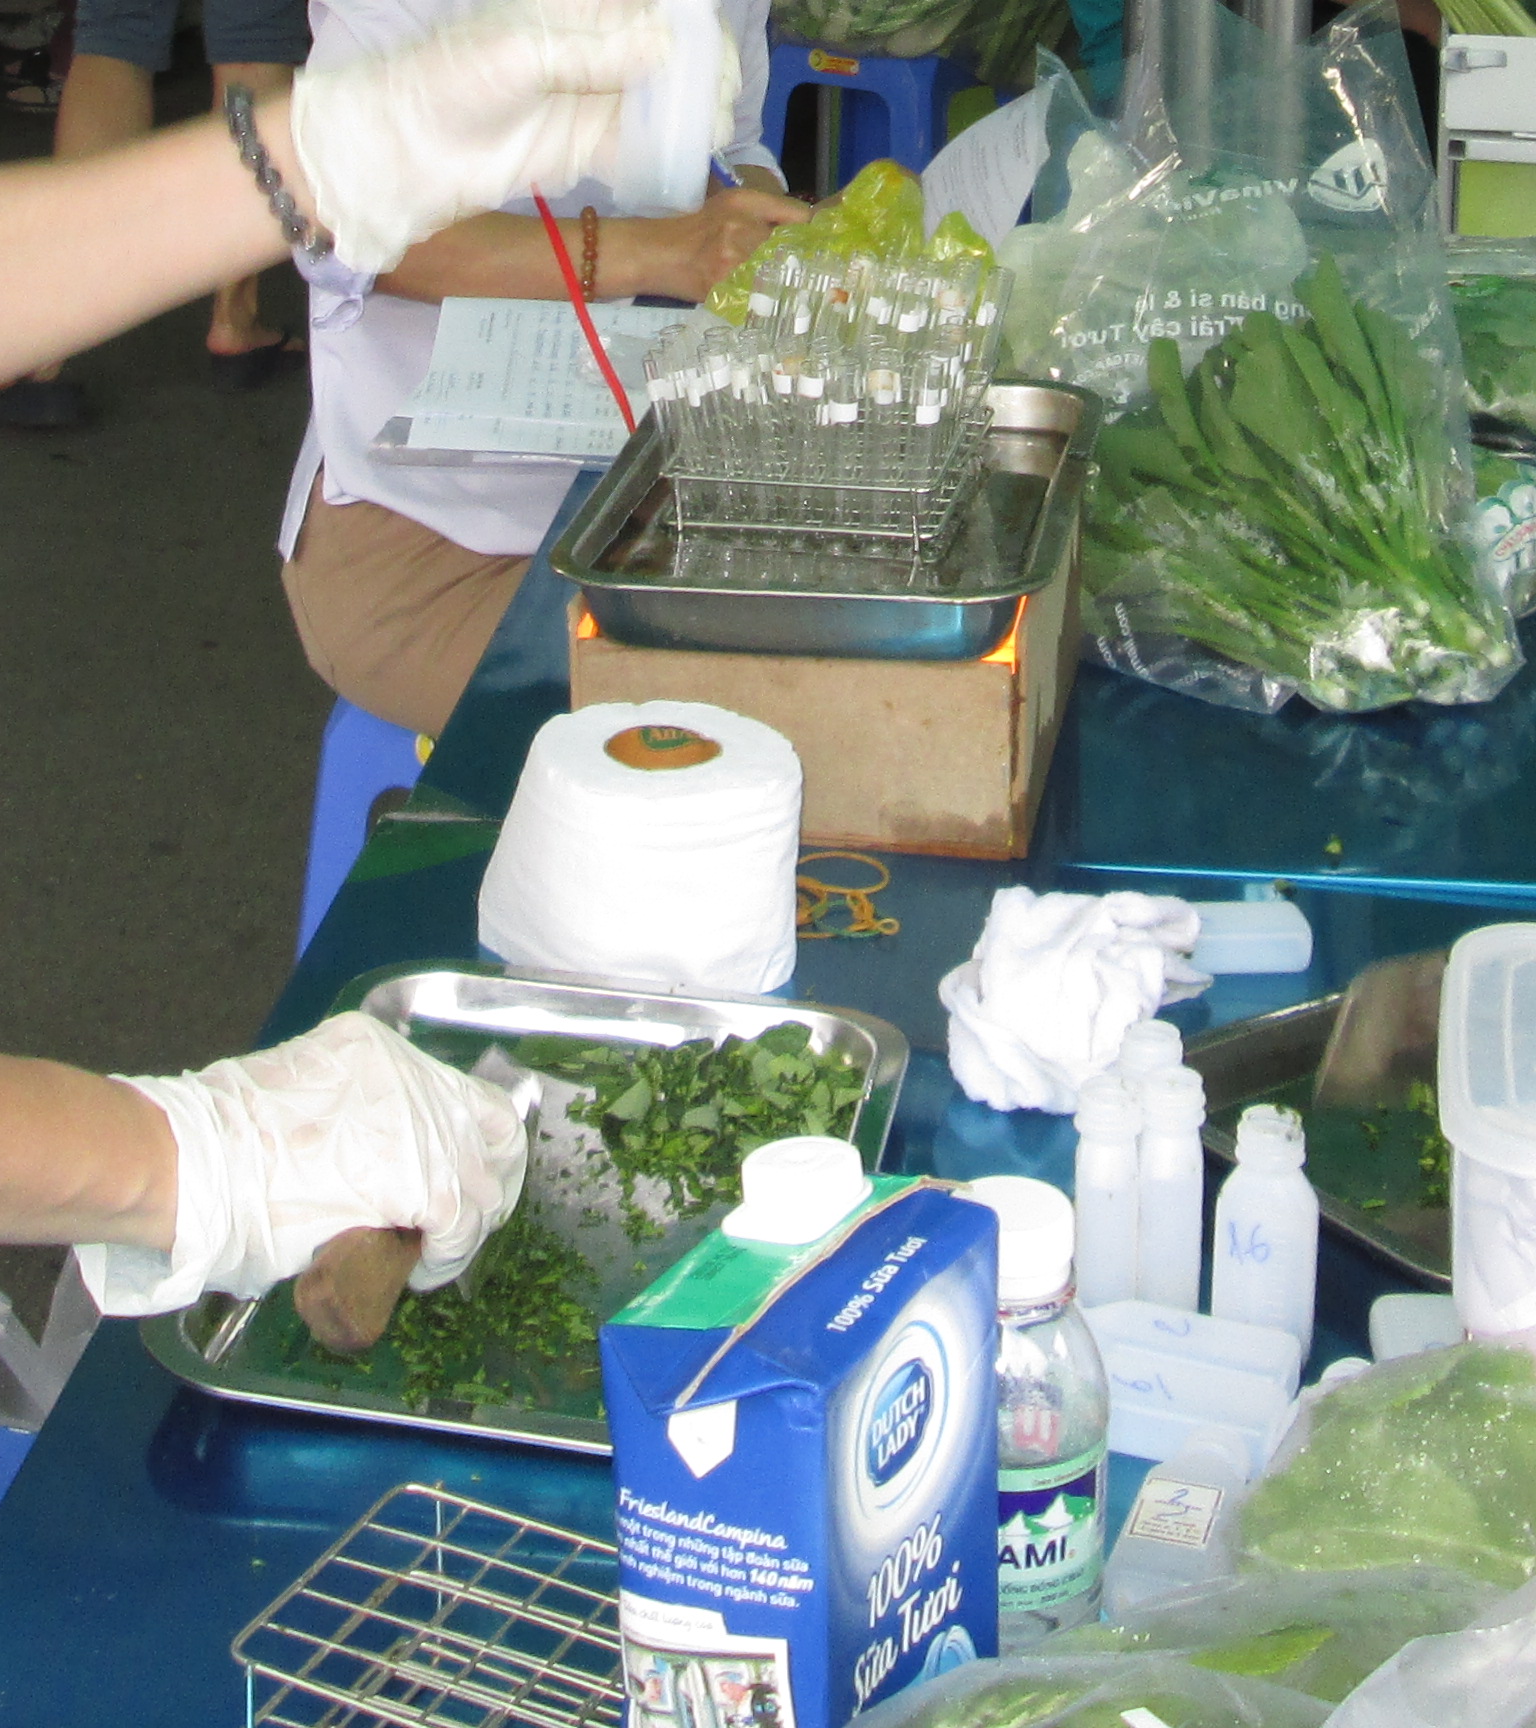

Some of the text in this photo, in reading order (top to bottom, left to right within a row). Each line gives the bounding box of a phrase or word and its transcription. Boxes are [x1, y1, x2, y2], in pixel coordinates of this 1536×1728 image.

[826, 1235, 929, 1332] 100% Sữa Tươi
[872, 1375, 926, 1448] DUTCH
[878, 1409, 920, 1469] LADY
[619, 1486, 789, 1551] FrieslandCampina
[686, 1574, 723, 1598] trong
[724, 1584, 768, 1604] ngành
[745, 1550, 781, 1570] đoàn
[782, 1558, 810, 1573] sữa
[866, 1511, 943, 1629] 100%
[851, 1559, 964, 1719] Sữa Tươi
